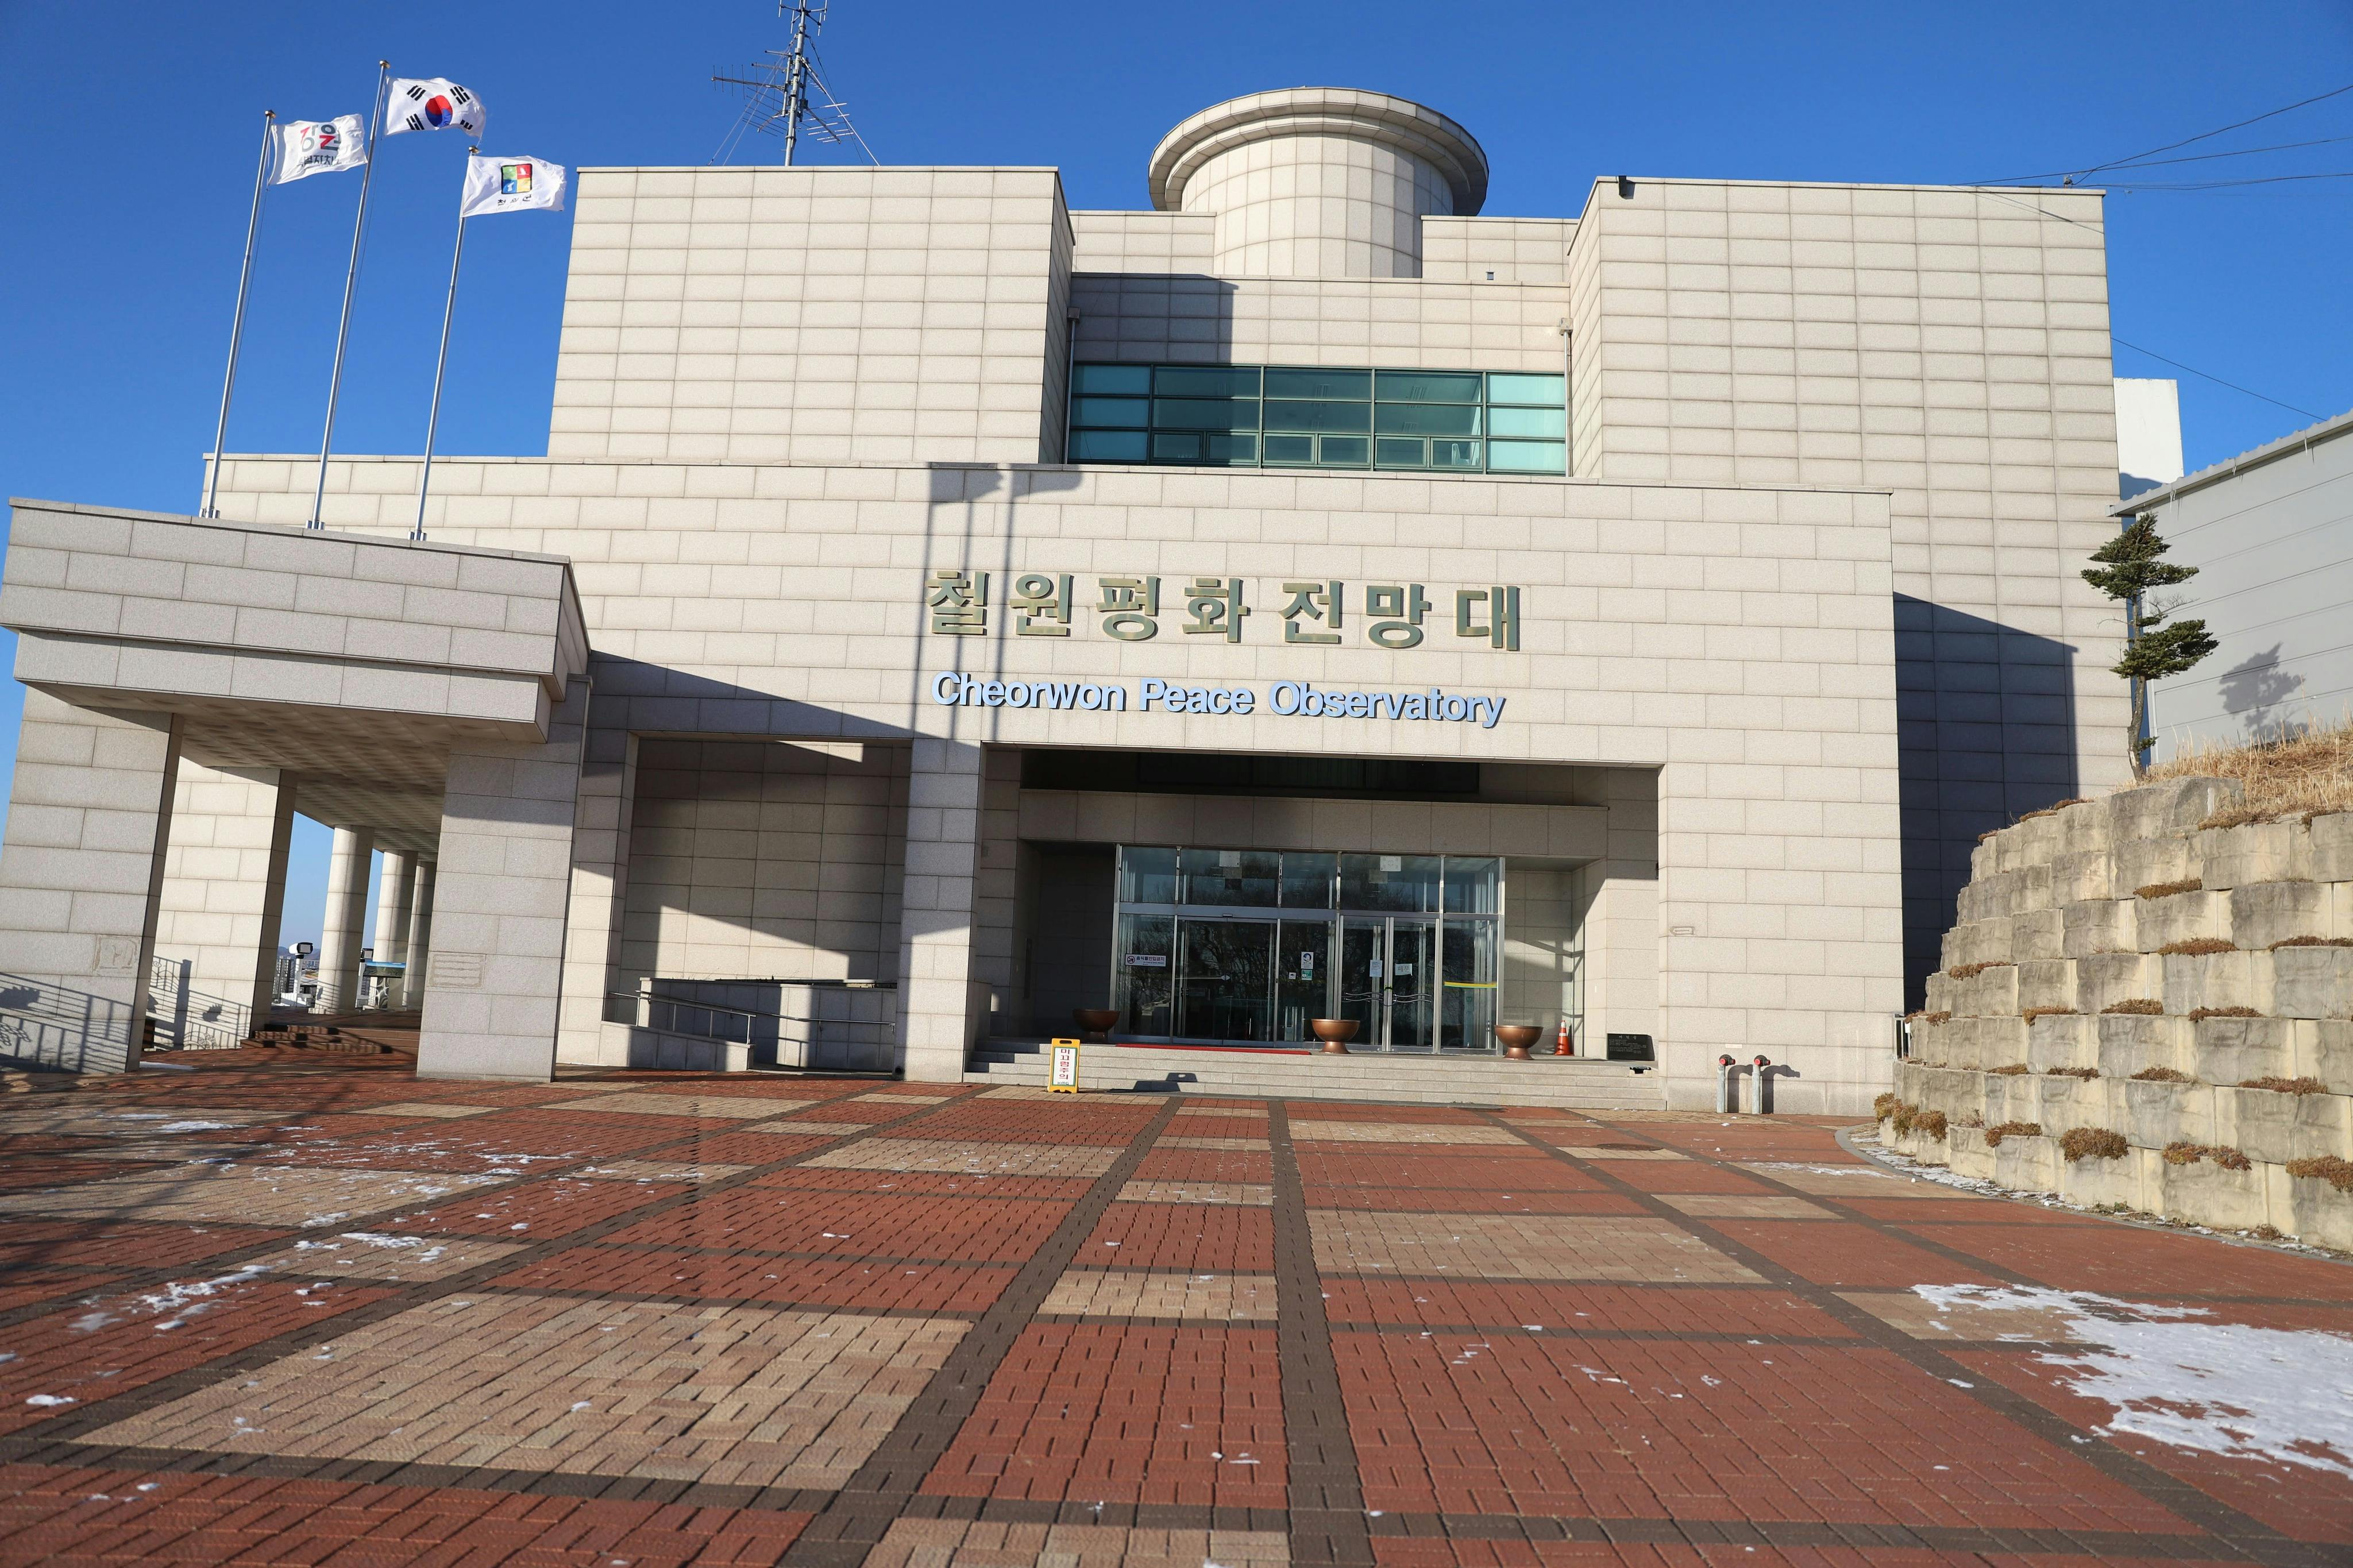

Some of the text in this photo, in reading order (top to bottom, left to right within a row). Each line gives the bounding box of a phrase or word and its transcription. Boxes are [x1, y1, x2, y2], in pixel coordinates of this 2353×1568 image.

[931, 671, 1506, 728] Cheorwon Peace Observatory
